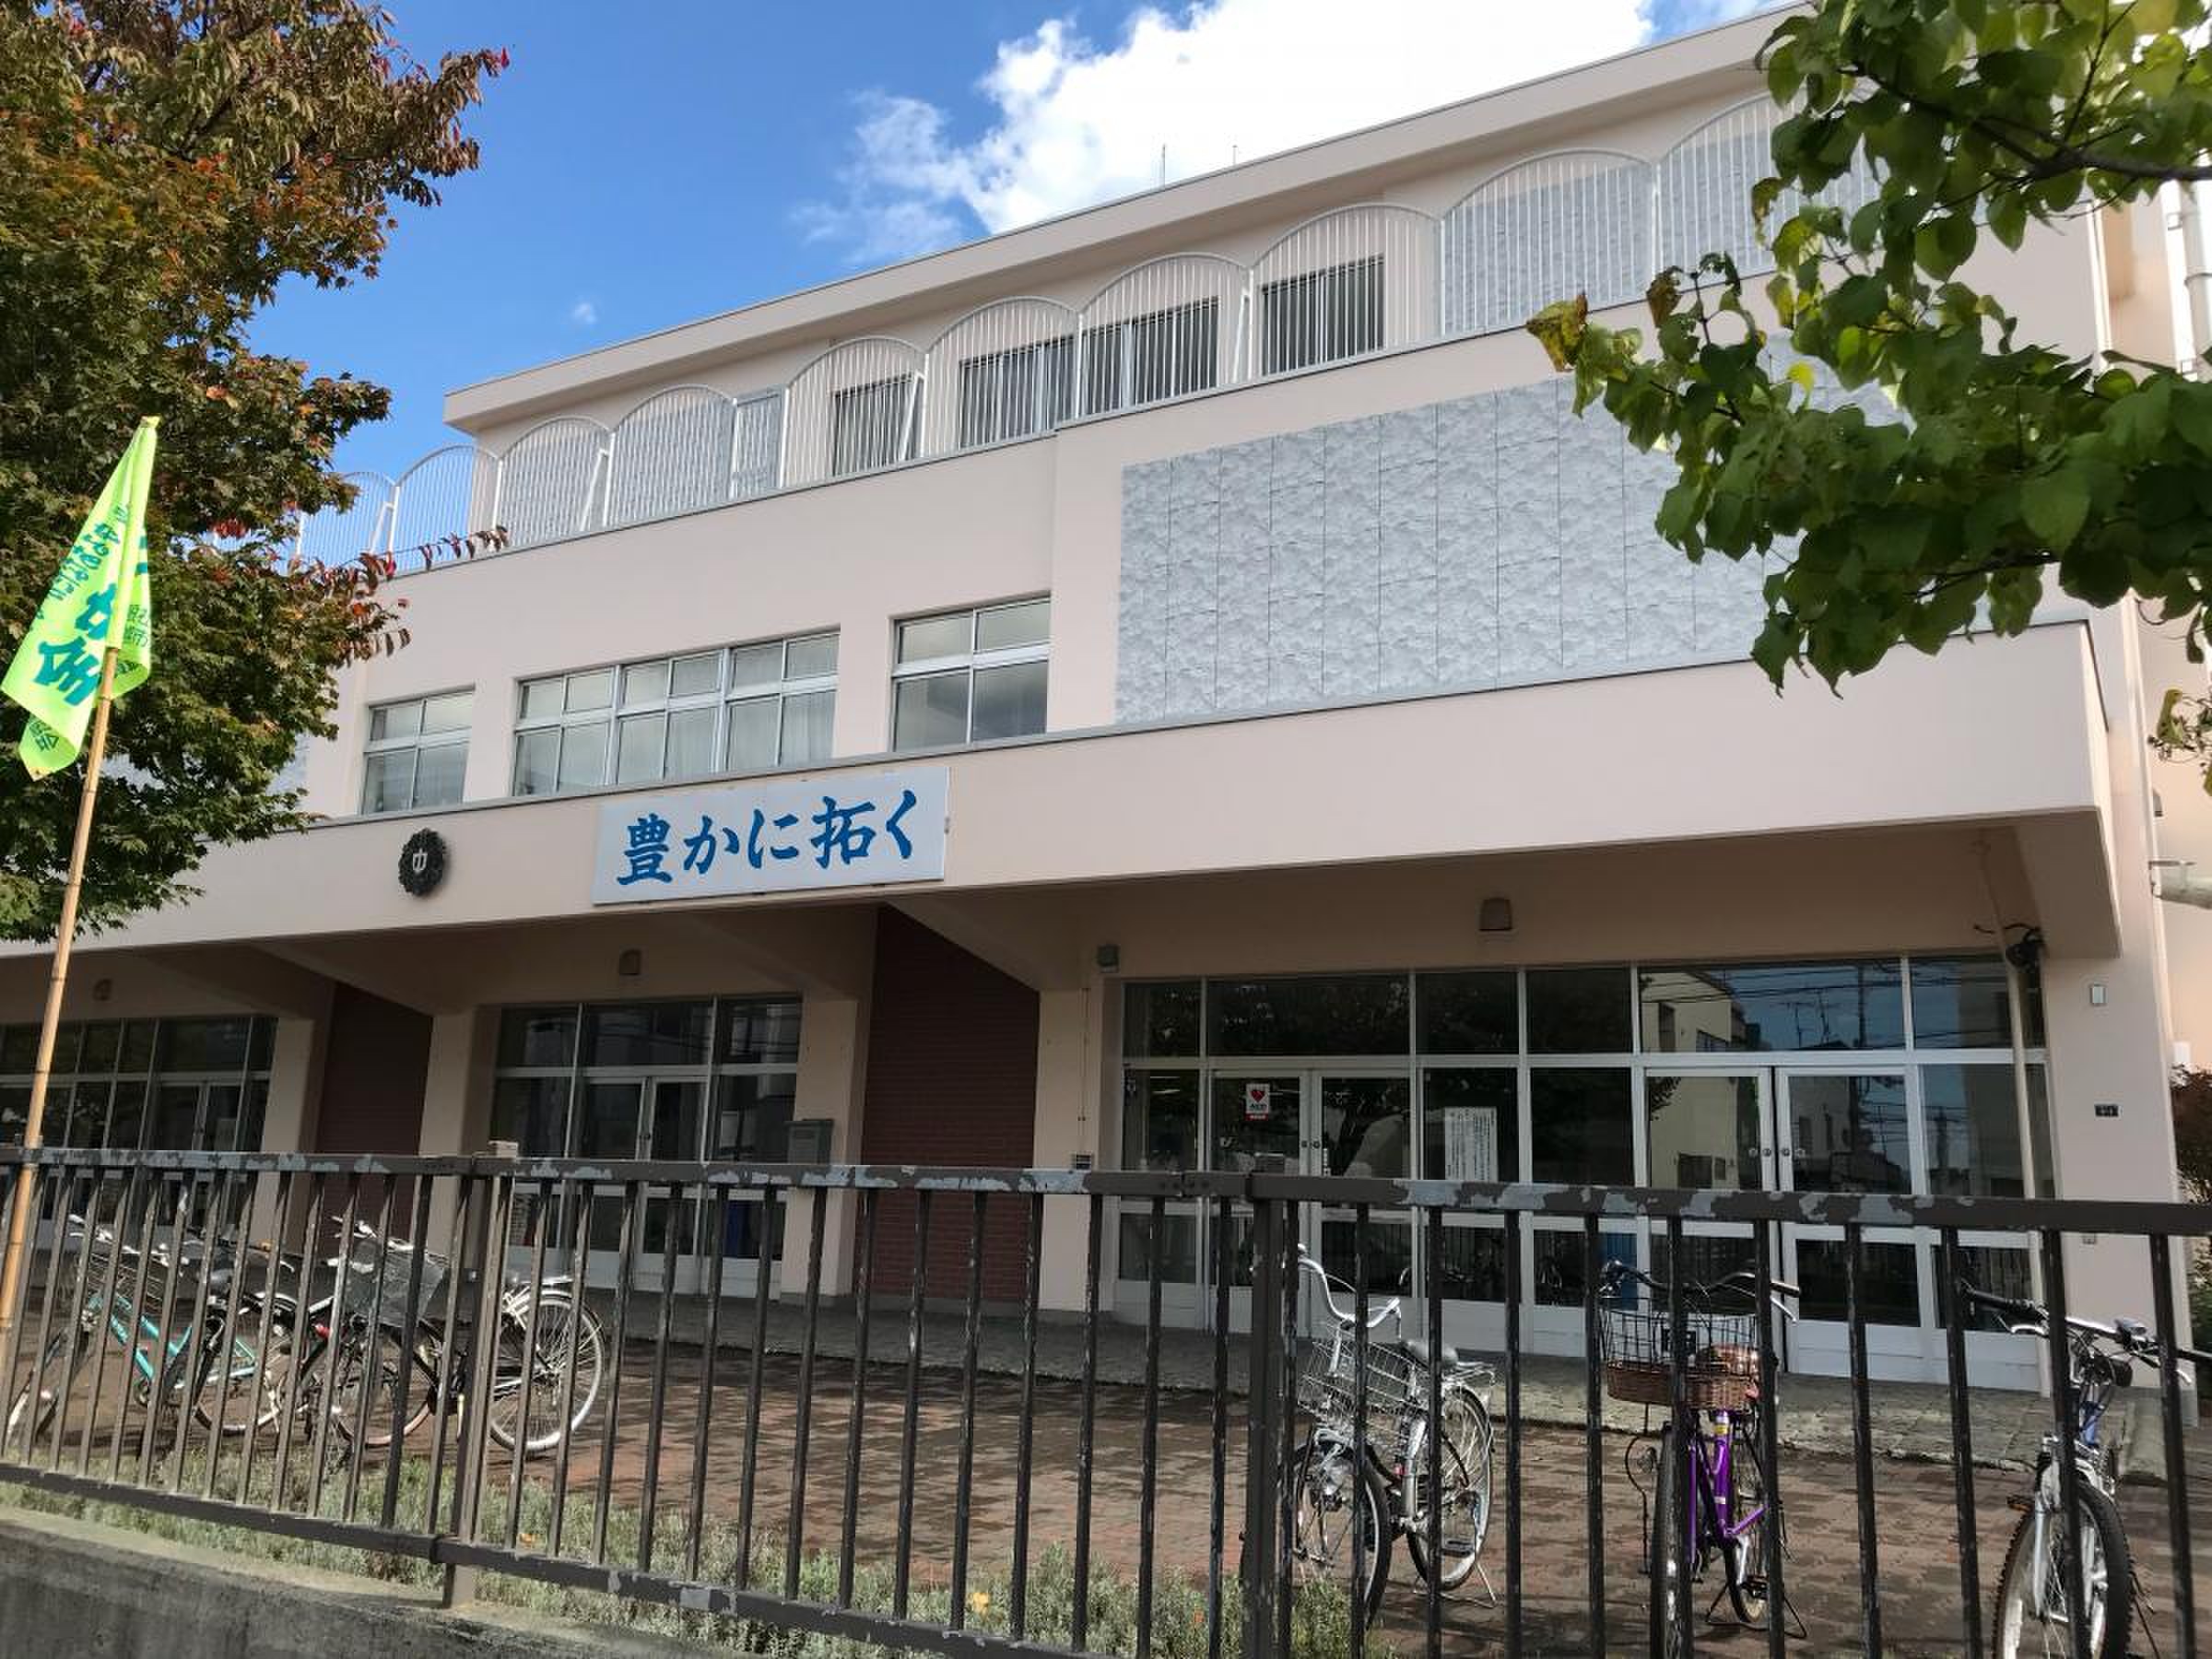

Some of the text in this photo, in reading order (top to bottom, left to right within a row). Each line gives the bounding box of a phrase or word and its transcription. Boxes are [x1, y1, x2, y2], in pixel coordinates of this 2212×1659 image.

[412, 848, 428, 874] 中
[617, 789, 917, 886] 豊かに拓く
